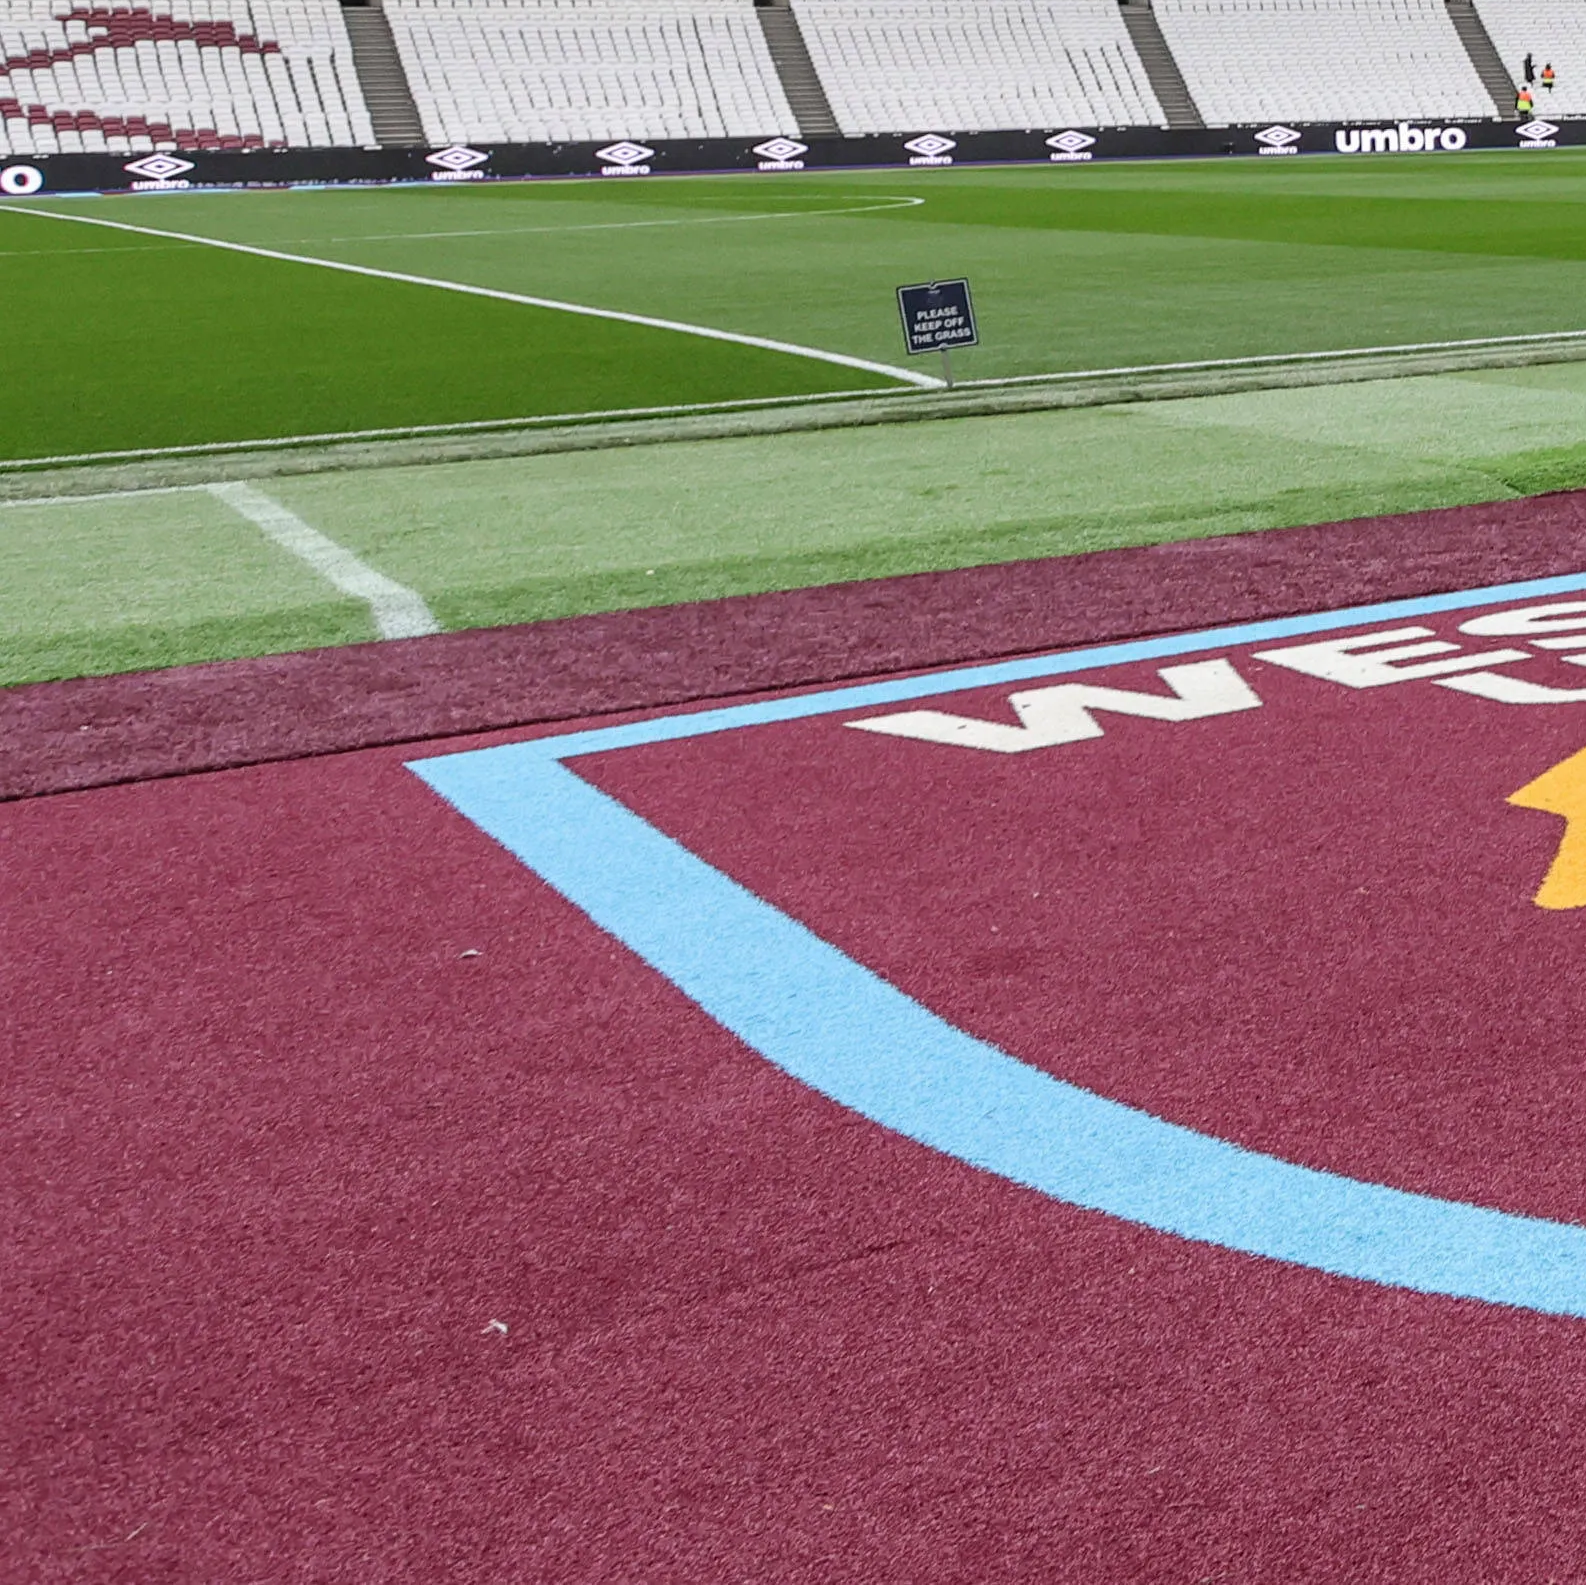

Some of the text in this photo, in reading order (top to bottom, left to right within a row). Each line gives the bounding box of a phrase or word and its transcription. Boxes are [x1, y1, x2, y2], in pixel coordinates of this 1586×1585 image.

[1335, 122, 1467, 153] umbro
[1519, 139, 1556, 148] umbro
[1258, 145, 1298, 155] umbro
[909, 155, 952, 165] umbro
[1050, 151, 1092, 161] umbro
[602, 165, 650, 175] umbro
[758, 160, 804, 170] umbro
[432, 169, 484, 180] umbro
[131, 179, 190, 190] umbro
[917, 305, 958, 320] PLEASE
[914, 316, 964, 333] KEEP OFF
[911, 327, 971, 345] THE GRASS
